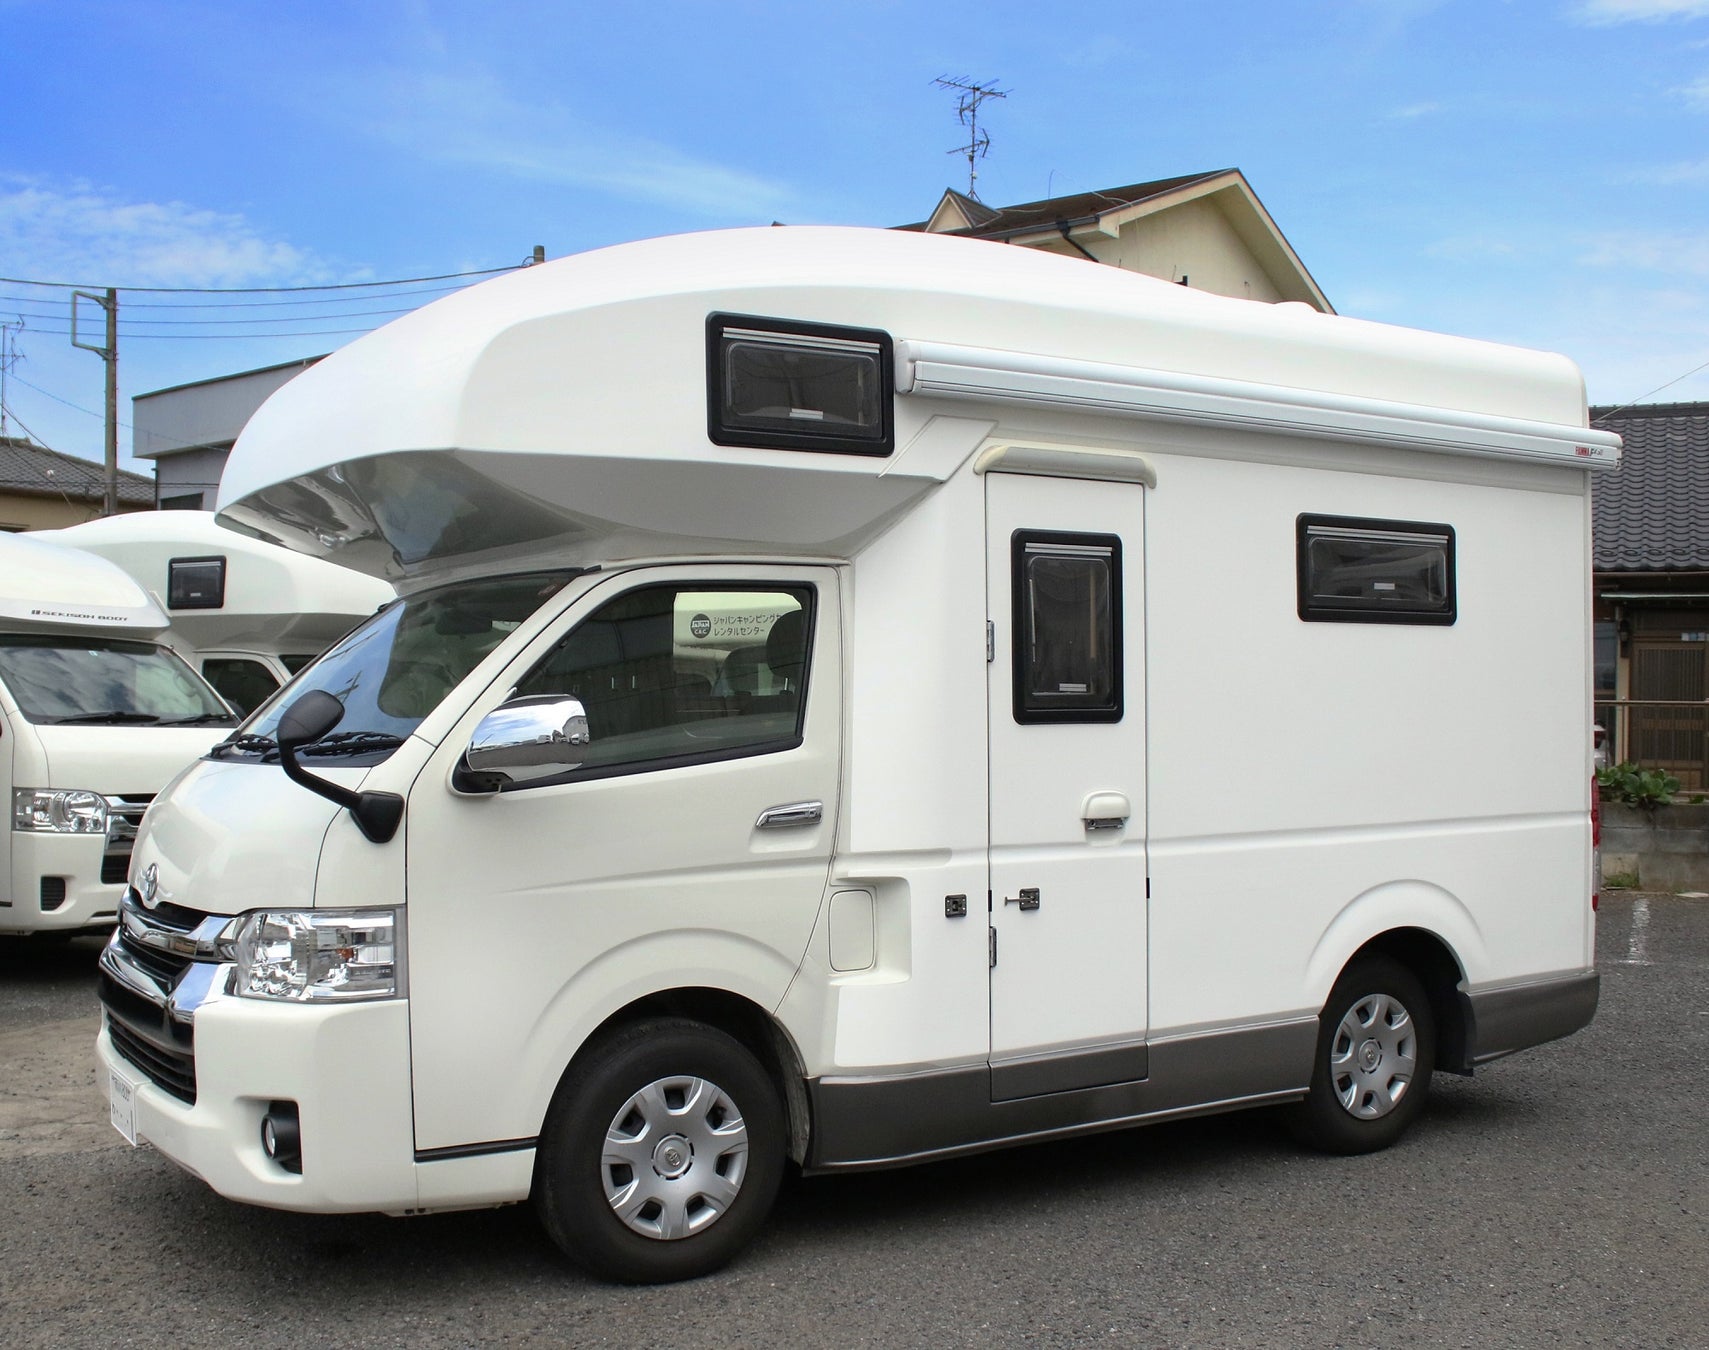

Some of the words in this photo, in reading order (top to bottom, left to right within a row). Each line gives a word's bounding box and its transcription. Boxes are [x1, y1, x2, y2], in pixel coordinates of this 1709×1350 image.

[714, 627, 765, 636] レンタルセンター
